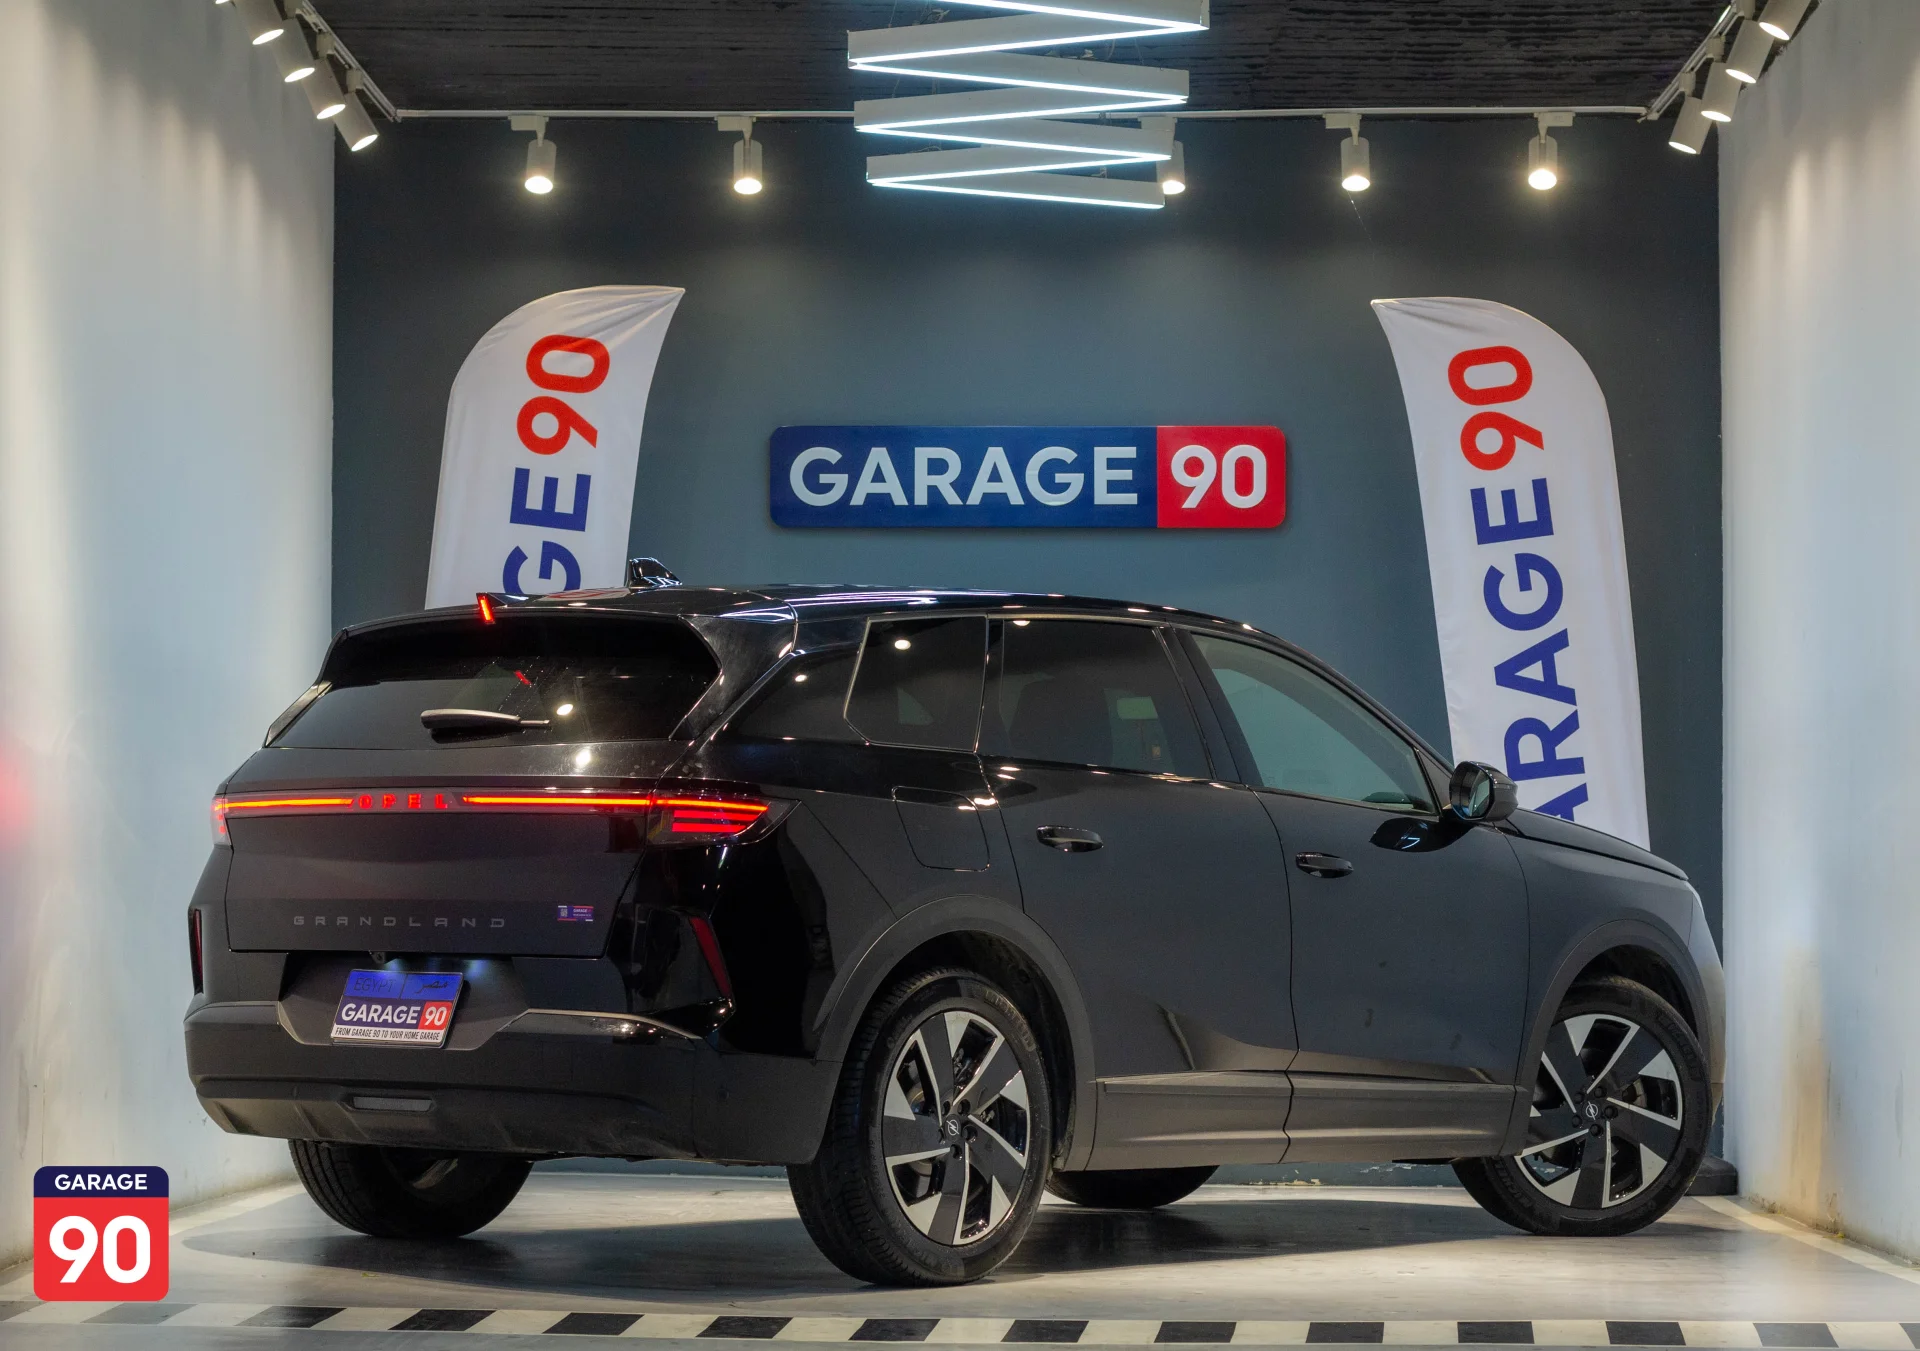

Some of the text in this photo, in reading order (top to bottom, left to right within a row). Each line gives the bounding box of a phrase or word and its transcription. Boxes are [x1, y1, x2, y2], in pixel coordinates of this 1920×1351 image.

[516, 334, 610, 455] 90
[1447, 345, 1545, 471] 90
[789, 444, 1268, 509] GARAGE 90
[357, 793, 449, 809] OPEL
[293, 915, 505, 928] GRANDLAND
[353, 977, 396, 992] EGYPT
[341, 1003, 448, 1026] GARAGE 90
[335, 1027, 350, 1036] FROM
[352, 1029, 372, 1037] GARAGE
[373, 1030, 380, 1038] 90
[382, 1030, 388, 1038] TO
[389, 1031, 404, 1039] YOUR
[420, 1032, 440, 1040] GARAGE
